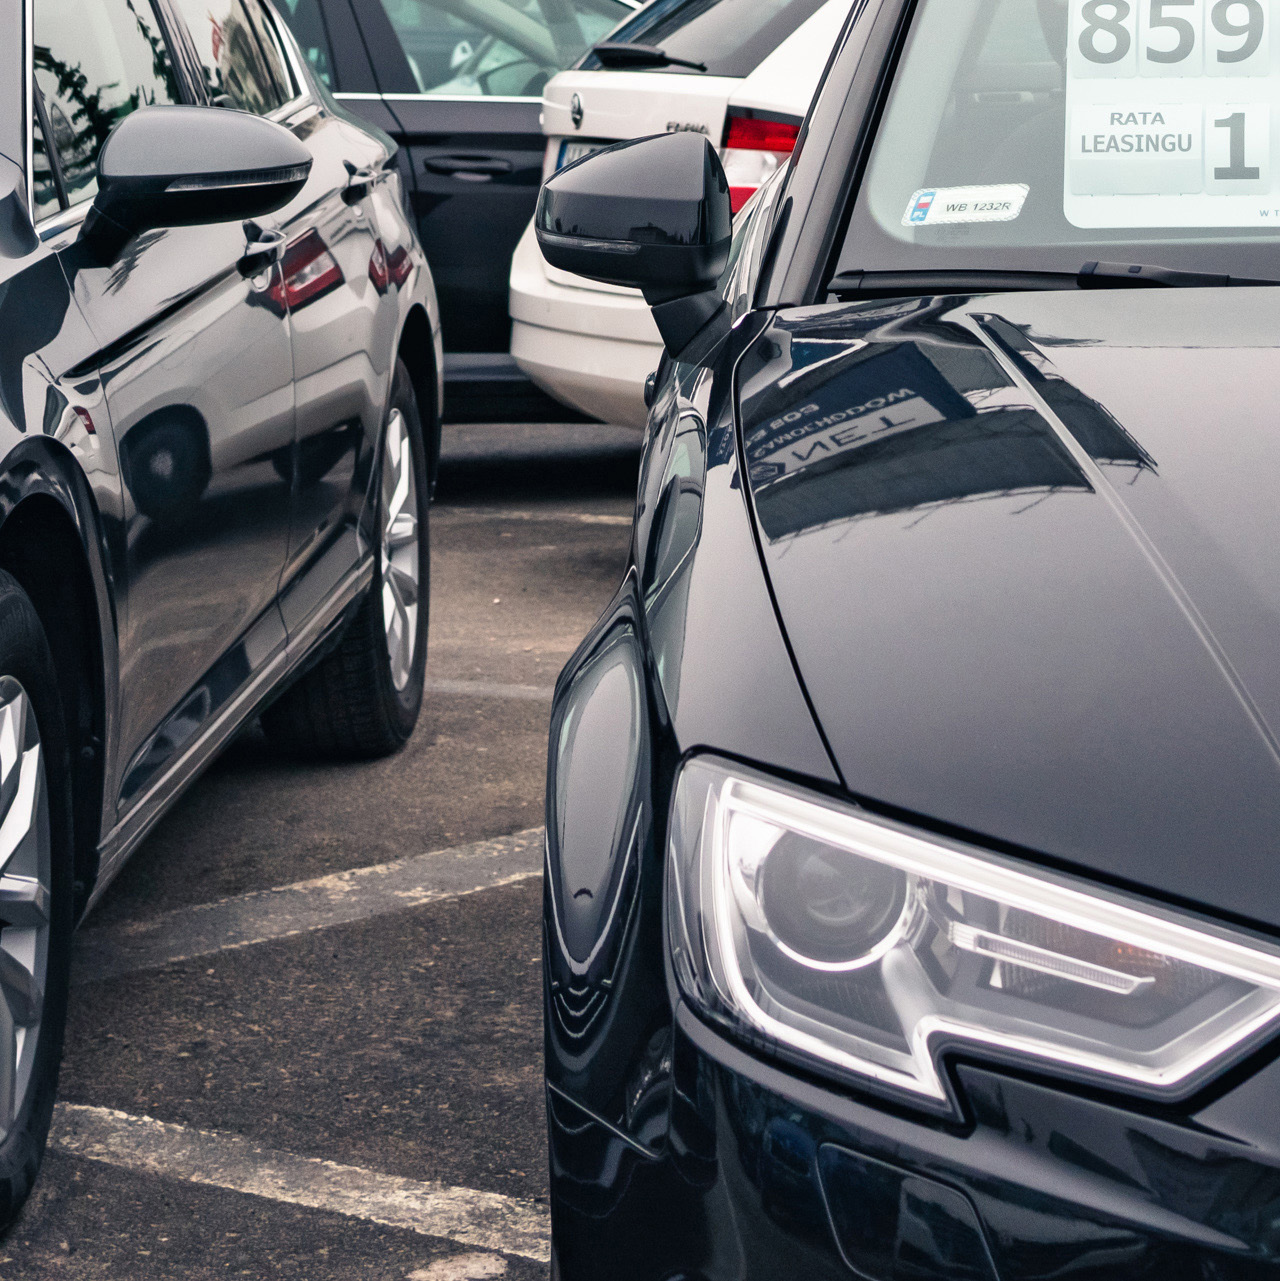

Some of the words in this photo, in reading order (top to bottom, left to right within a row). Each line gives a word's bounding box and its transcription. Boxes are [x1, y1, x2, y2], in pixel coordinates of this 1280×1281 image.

[1109, 111, 1166, 126] RATA
[1080, 133, 1193, 154] LEASINGU
[946, 203, 968, 213] WB
[1259, 209, 1270, 217] W
